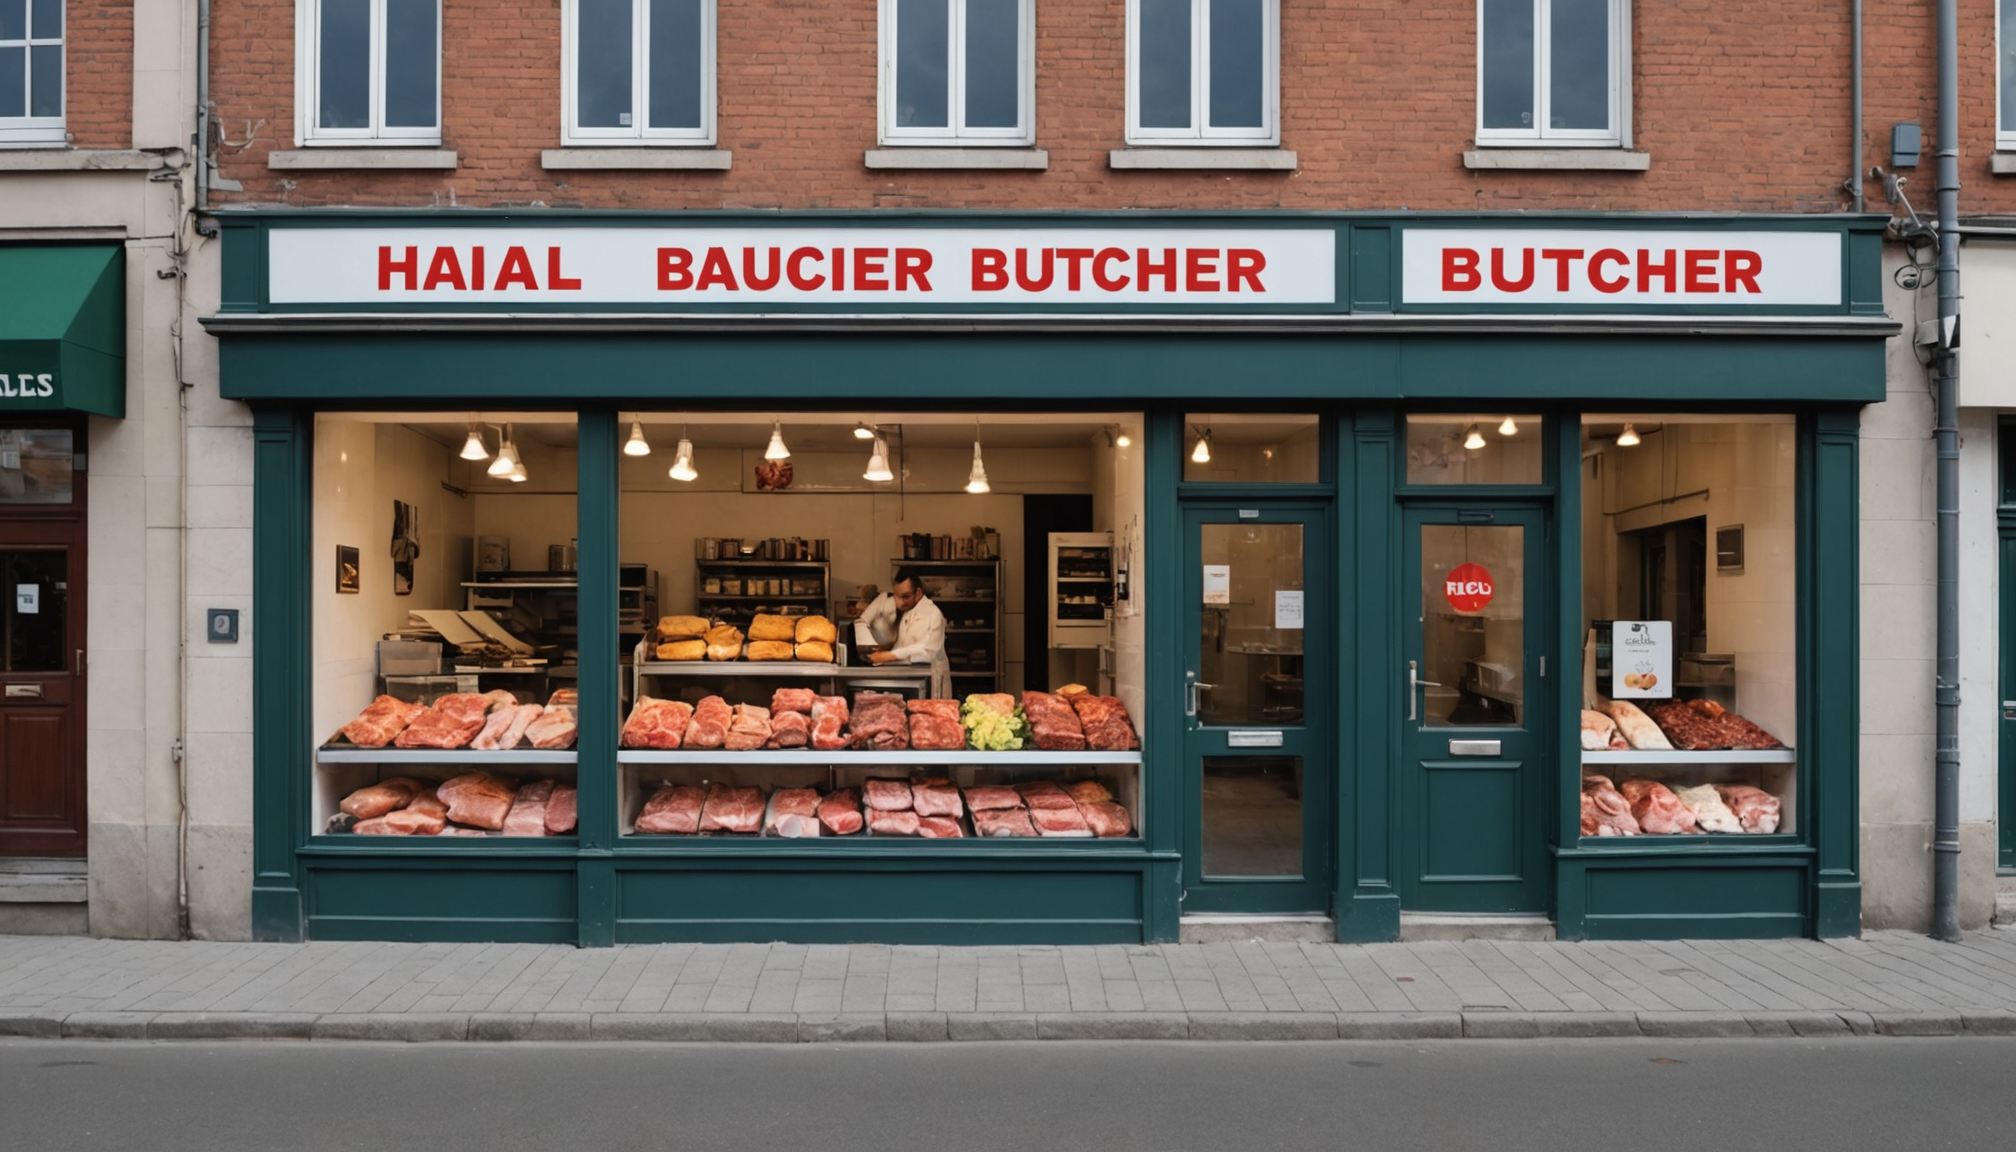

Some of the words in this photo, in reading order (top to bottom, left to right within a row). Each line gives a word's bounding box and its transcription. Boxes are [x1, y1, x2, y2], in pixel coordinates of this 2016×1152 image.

[378, 246, 582, 291] HAIAL
[657, 246, 932, 292] BAUCIER
[972, 247, 1267, 292] BUTCHER
[1442, 248, 1763, 294] BUTCHER
